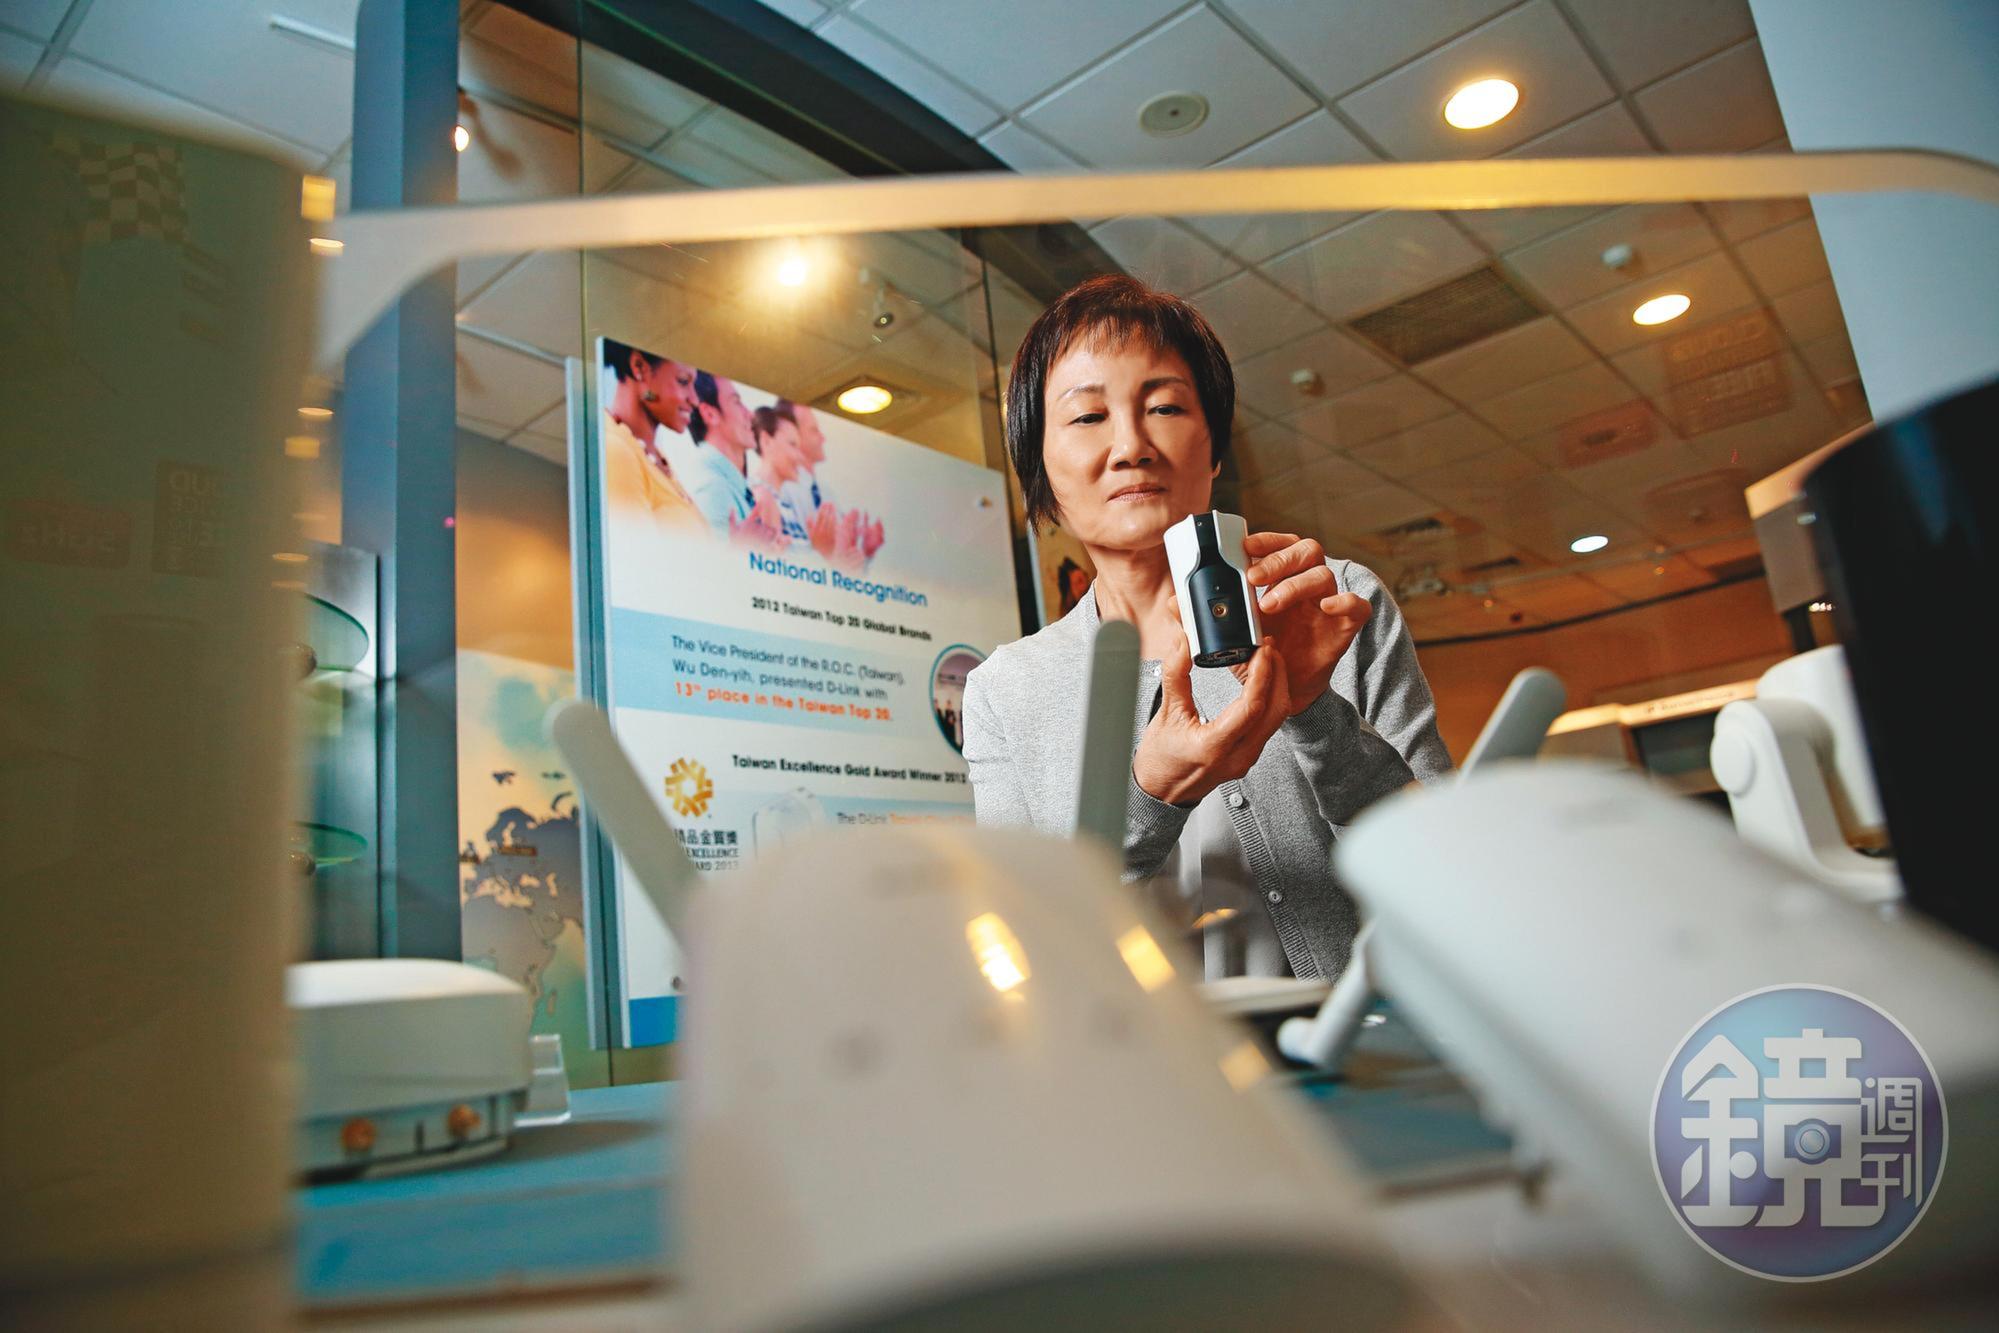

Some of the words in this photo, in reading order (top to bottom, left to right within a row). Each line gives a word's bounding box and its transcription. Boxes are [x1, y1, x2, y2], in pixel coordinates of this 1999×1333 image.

[749, 551, 828, 586] National
[831, 570, 929, 606] Recognition
[751, 596, 780, 613] 2012
[783, 602, 823, 621] Taiwan
[825, 611, 845, 626] Top
[863, 619, 896, 634] Global
[899, 625, 932, 641] Brands
[672, 635, 696, 651] The
[699, 640, 727, 657] Vice
[729, 644, 785, 664] President
[787, 653, 799, 667] of
[801, 657, 820, 670] the
[672, 659, 696, 674] Wu
[760, 672, 824, 693] presented
[826, 681, 861, 697] D-Link
[865, 686, 888, 700] with
[707, 688, 750, 704] place
[755, 692, 768, 705] in
[772, 694, 794, 709] the
[798, 696, 846, 716] Taiwan
[849, 703, 872, 720] Top
[732, 754, 777, 771] Taiwan
[780, 758, 842, 775] Excellence
[844, 763, 872, 777] Gold
[873, 766, 907, 780] Award
[909, 768, 942, 782] Winner
[837, 811, 856, 825] The
